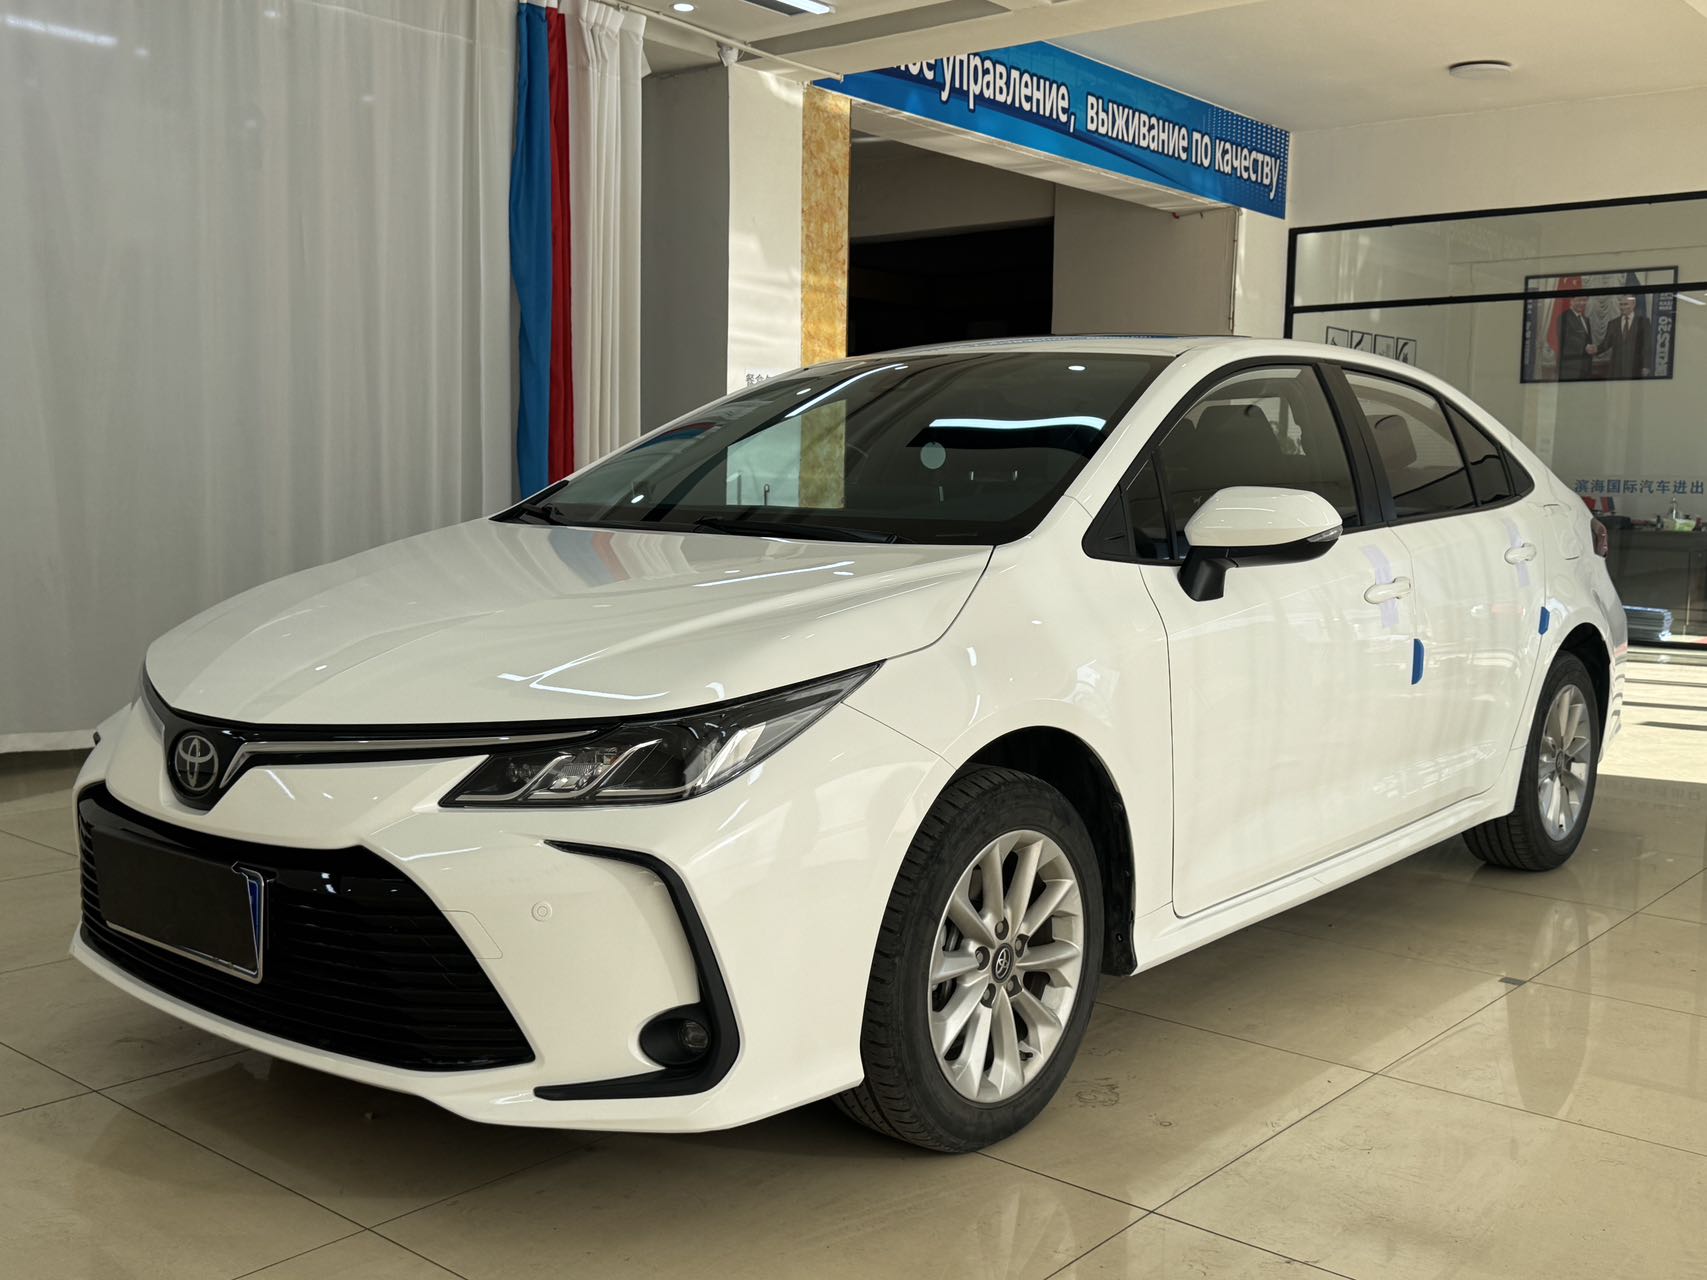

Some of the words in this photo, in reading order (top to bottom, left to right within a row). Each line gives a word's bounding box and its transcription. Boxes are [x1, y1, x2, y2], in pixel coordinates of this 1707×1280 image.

[941, 54, 1075, 133] управление,
[1087, 95, 1188, 160] выживание
[1192, 131, 1211, 167] по
[1215, 138, 1280, 200] качеству
